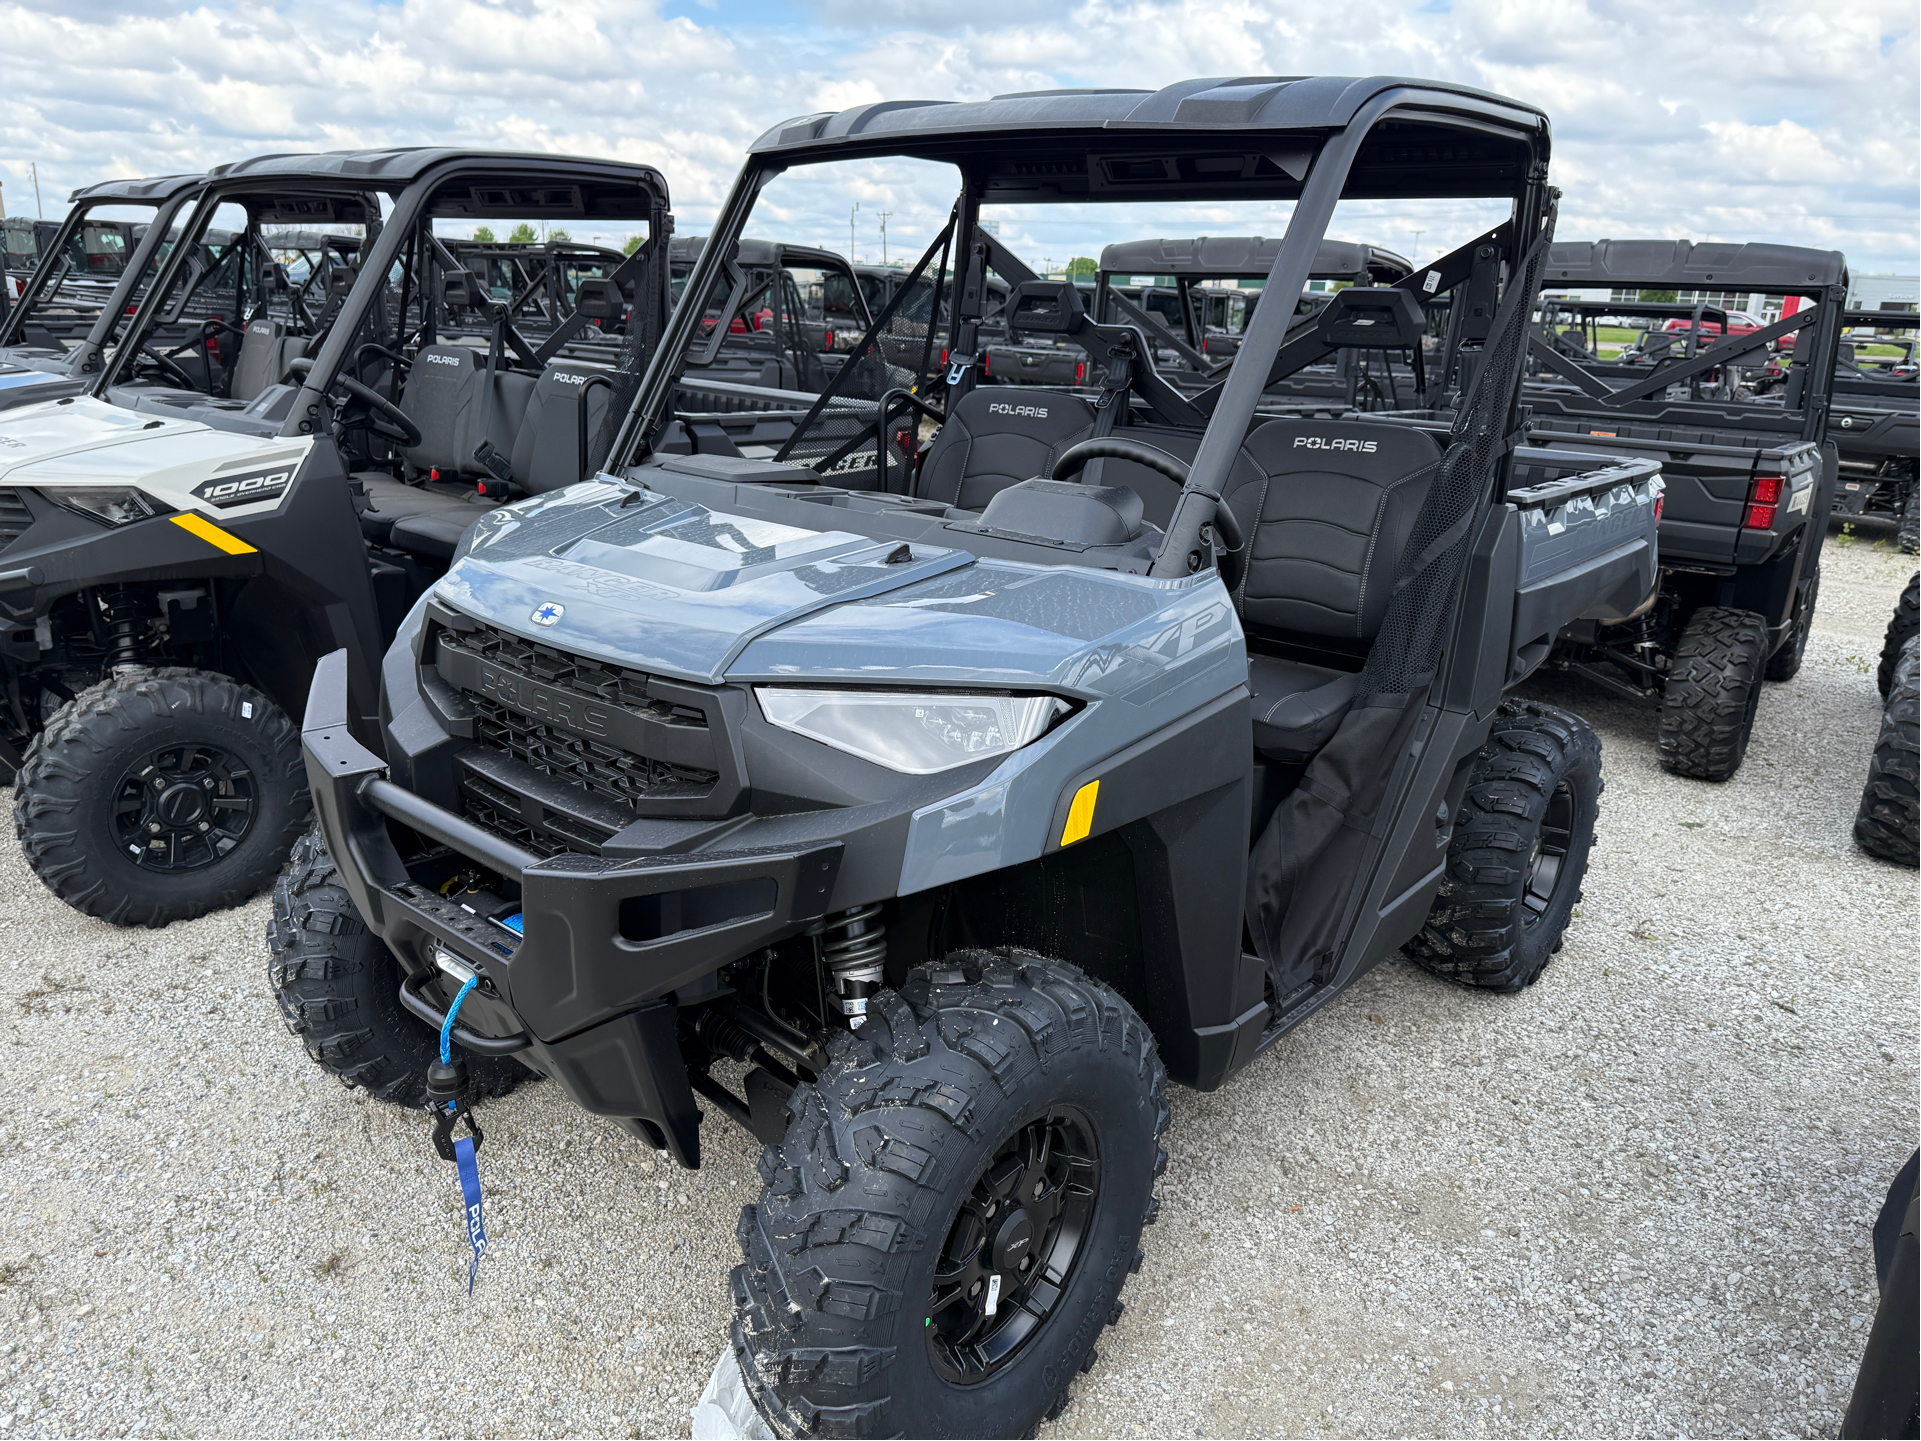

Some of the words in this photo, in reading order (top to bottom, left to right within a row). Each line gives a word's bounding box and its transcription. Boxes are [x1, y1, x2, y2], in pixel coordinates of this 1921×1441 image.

[253, 325, 270, 335] POLARIS
[427, 354, 460, 367] POLARIS
[553, 372, 586, 386] POLAR
[989, 403, 1049, 418] POLARIS
[1293, 437, 1378, 453] POLARIS
[203, 472, 289, 499] 1000
[211, 493, 235, 502] SINGLE
[237, 486, 271, 497] OVERHEAD
[272, 483, 287, 491] CAM
[522, 558, 681, 601] RANGER
[562, 582, 641, 601] XP
[1085, 601, 1233, 697] XP
[481, 666, 609, 737] POLARIS
[468, 1203, 487, 1258] POLA
[1105, 1235, 1132, 1285] PRO
[1055, 1284, 1112, 1370] ARMOR
